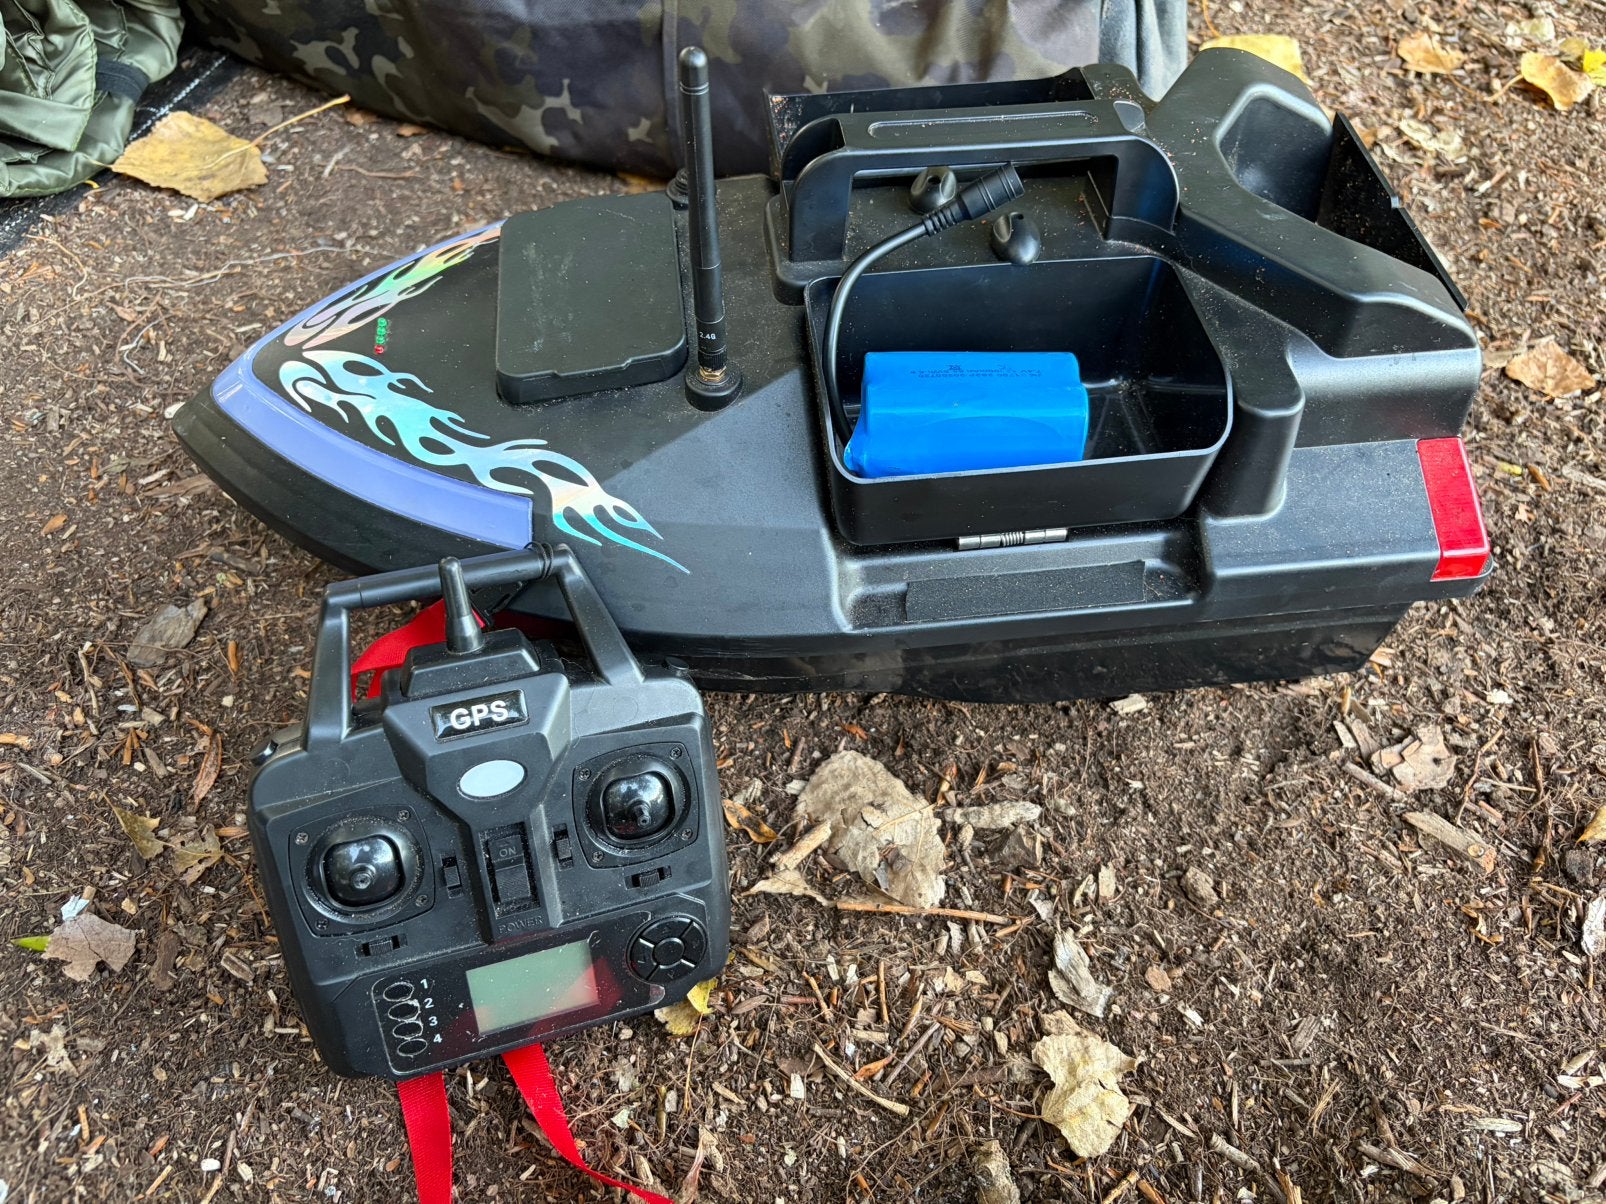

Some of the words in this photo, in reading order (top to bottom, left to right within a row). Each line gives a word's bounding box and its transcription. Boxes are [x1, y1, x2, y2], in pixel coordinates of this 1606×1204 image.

[450, 700, 508, 730] GPS
[500, 846, 517, 857] ON
[499, 915, 543, 934] POWER
[420, 978, 428, 989] 1
[424, 997, 435, 1009] 2
[428, 1015, 438, 1027] 3
[433, 1033, 443, 1043] 4
